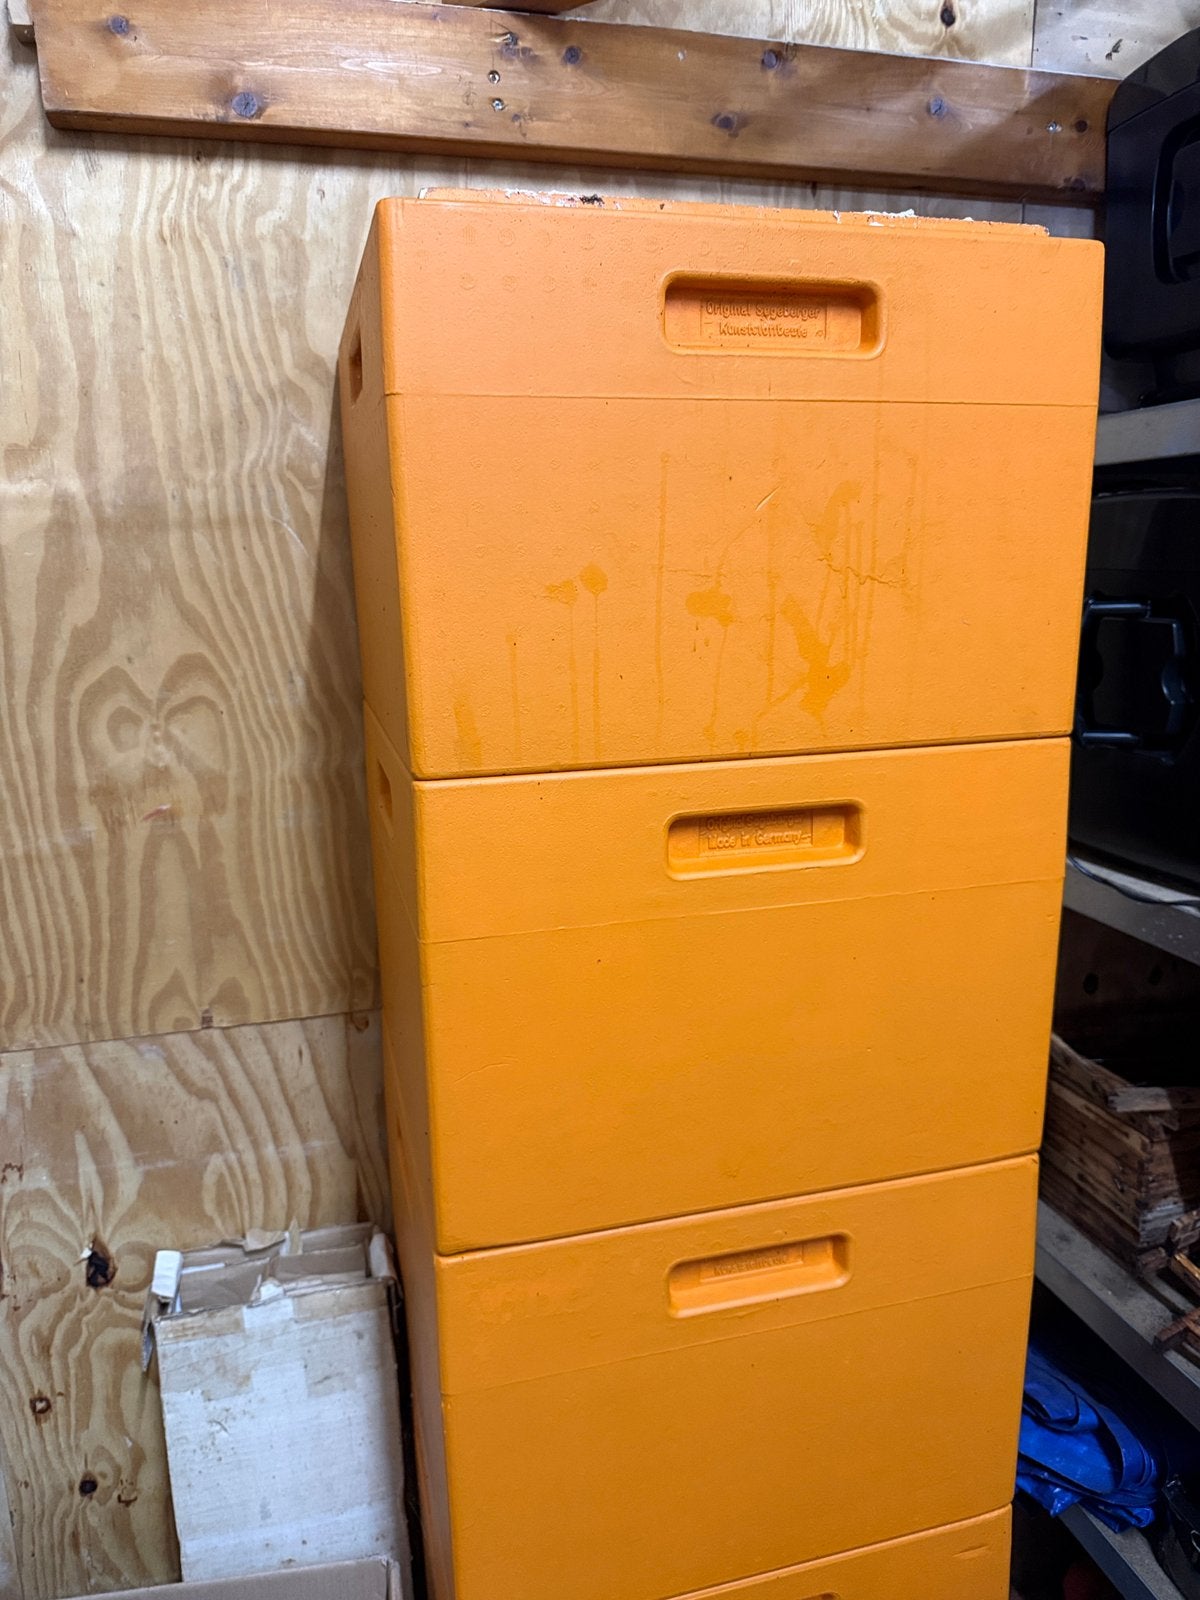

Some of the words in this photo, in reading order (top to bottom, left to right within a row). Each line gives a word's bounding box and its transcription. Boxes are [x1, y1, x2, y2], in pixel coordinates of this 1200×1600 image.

[706, 301, 751, 318] Original
[708, 833, 736, 850] Made
[741, 831, 750, 847] in
[755, 830, 801, 845] Germany
